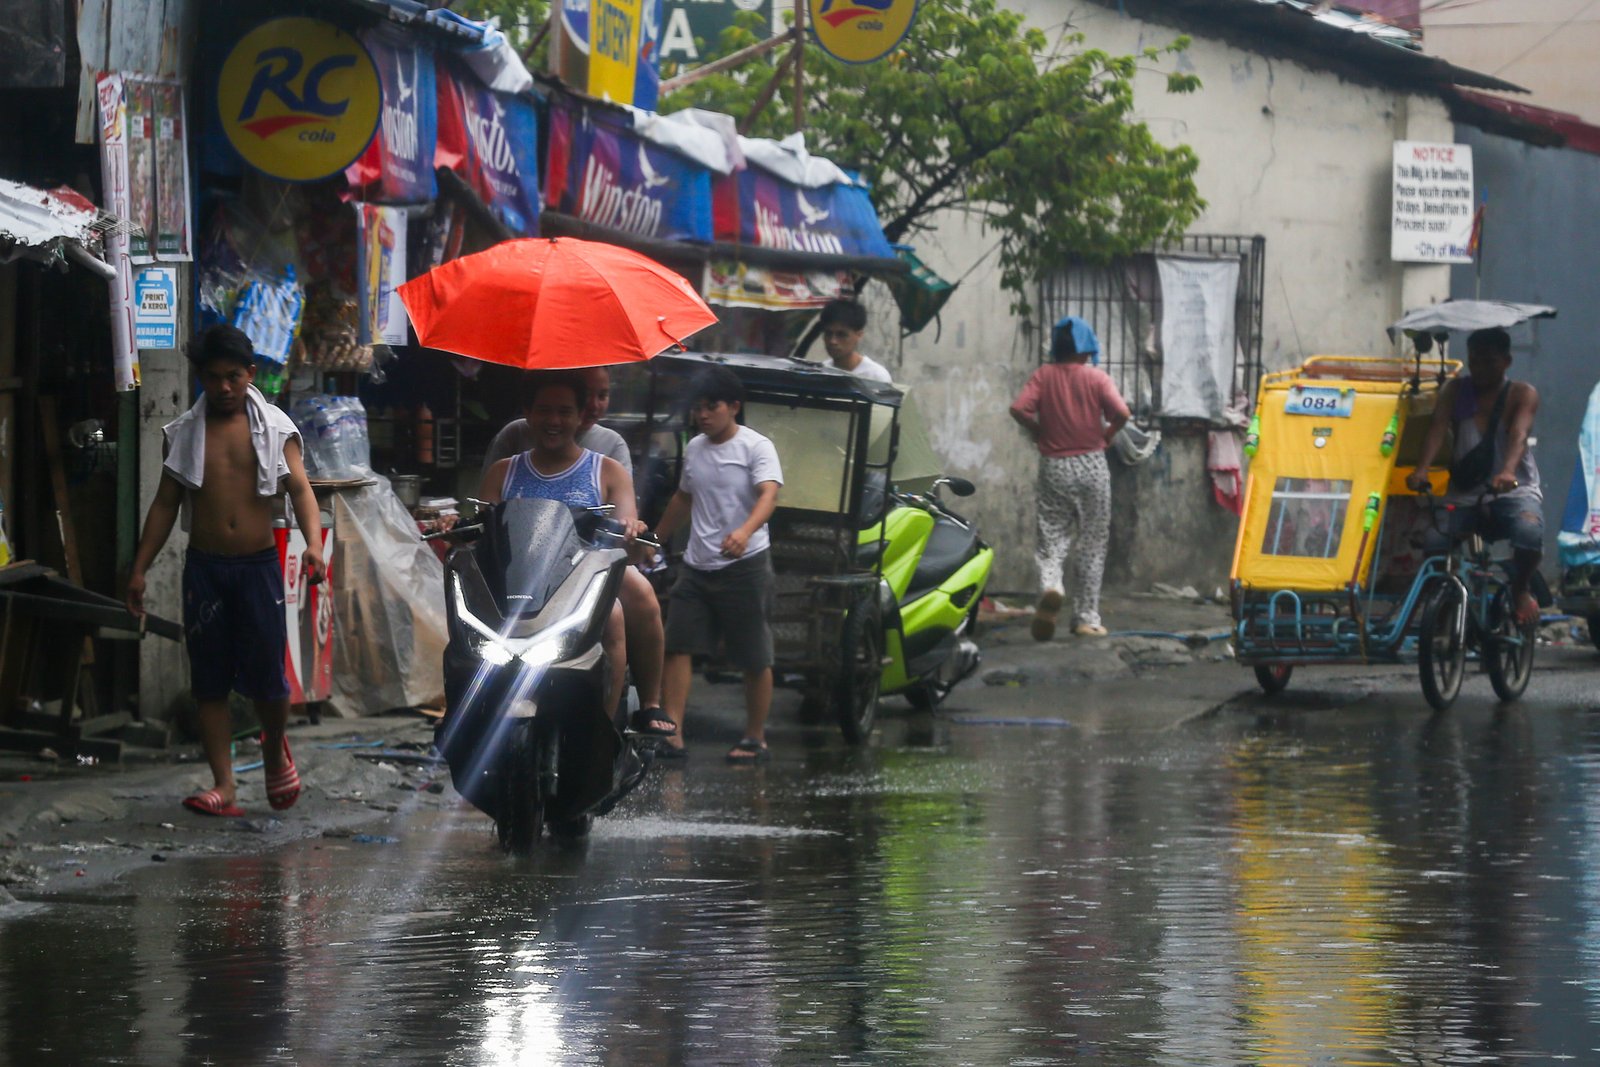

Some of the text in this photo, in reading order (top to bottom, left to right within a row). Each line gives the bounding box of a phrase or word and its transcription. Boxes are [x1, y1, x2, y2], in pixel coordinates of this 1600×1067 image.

[238, 47, 358, 123] RC
[298, 128, 337, 143] cola
[1413, 147, 1455, 163] NOTICE
[579, 154, 662, 238] Winston
[145, 293, 165, 301] PRINT
[136, 327, 173, 336] AVAILABLE
[1302, 397, 1336, 409] 084
